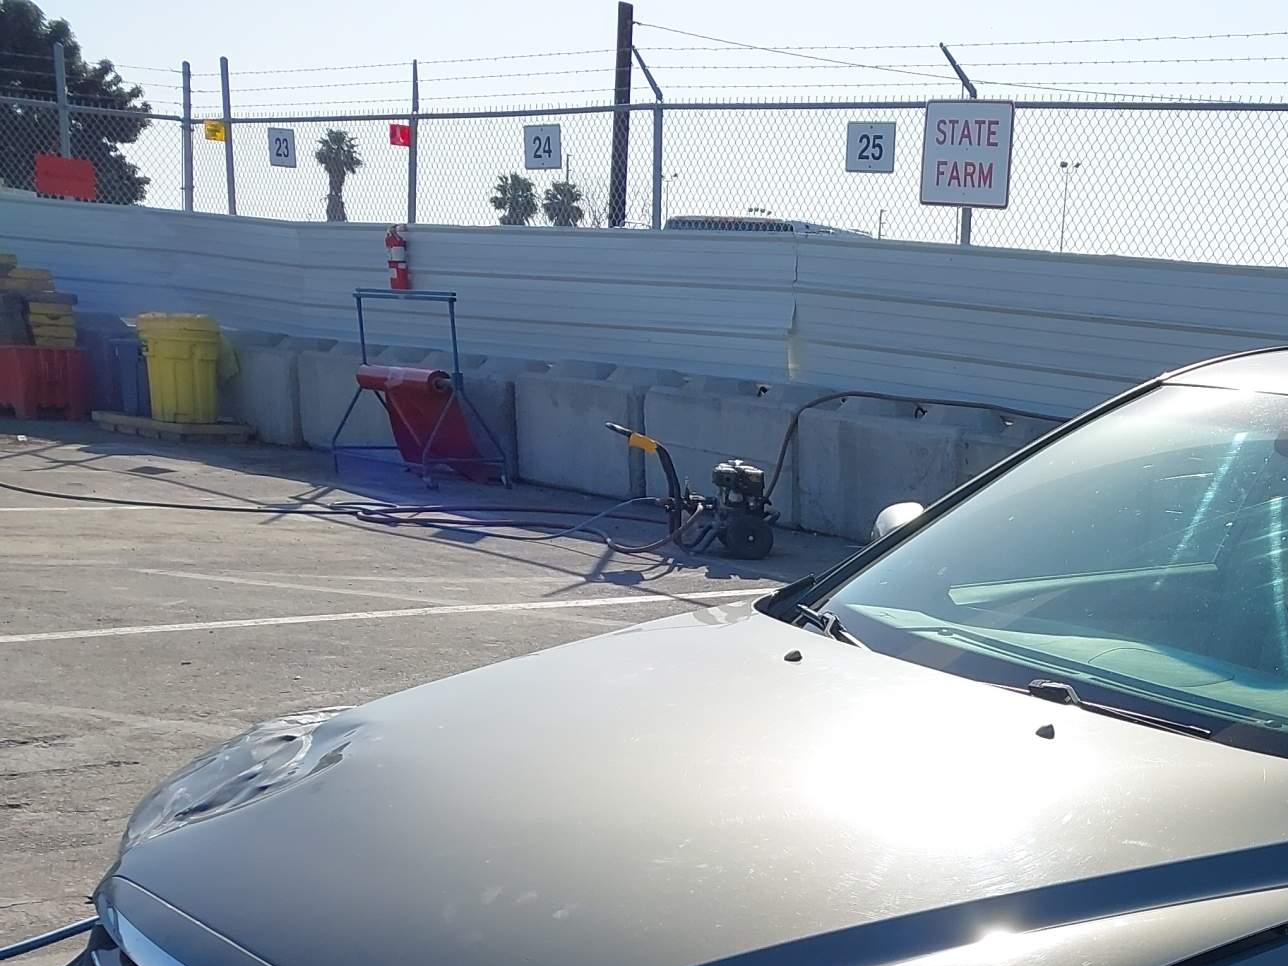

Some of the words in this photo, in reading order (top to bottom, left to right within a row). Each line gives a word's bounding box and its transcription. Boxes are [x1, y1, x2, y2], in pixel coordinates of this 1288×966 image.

[532, 135, 553, 159] 24
[936, 120, 1000, 147] STATE
[274, 137, 290, 158] 23
[857, 134, 884, 161] 25
[935, 161, 993, 188] FARM
